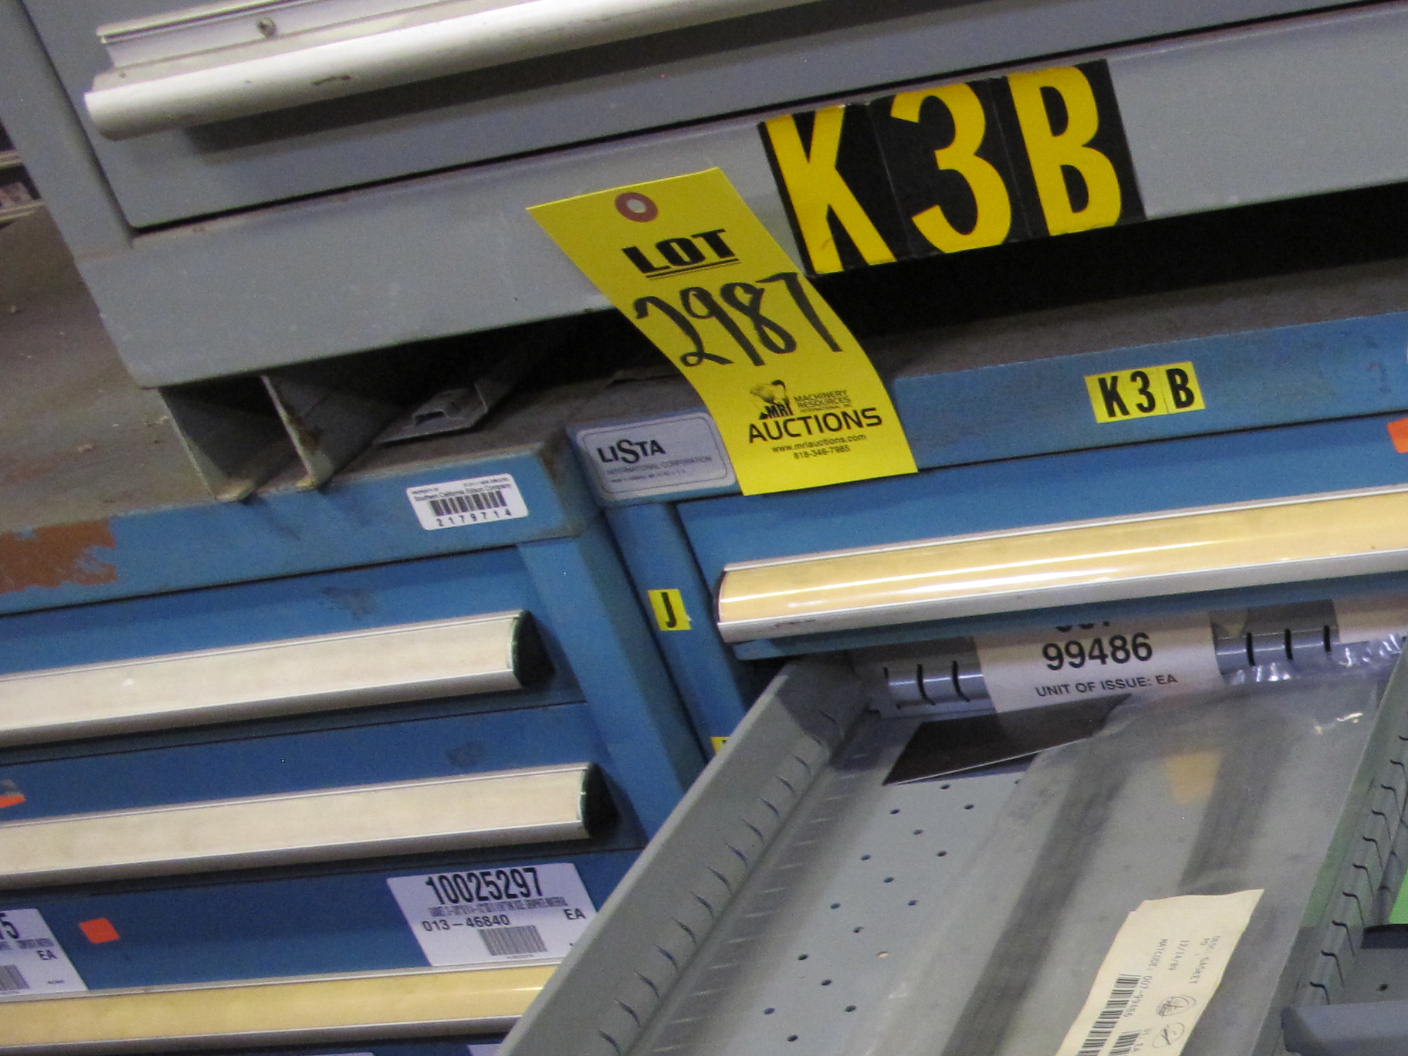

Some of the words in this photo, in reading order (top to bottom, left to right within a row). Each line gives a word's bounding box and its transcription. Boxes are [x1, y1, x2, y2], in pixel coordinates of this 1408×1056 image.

[764, 66, 1122, 274] K3B
[623, 229, 729, 273] LOT
[633, 271, 842, 368] 2987
[1099, 367, 1196, 418] K3B
[749, 407, 882, 443] AUCTIONS
[597, 439, 666, 463] LISTA
[661, 592, 677, 628] J
[1042, 632, 1153, 670] 99486
[1035, 683, 1070, 697] UNIT
[1075, 681, 1096, 693] OF
[1101, 677, 1152, 690] ISSUE:
[1155, 674, 1177, 685] EA
[425, 867, 543, 904] 10025297
[563, 908, 586, 921] EA
[37, 950, 58, 960] EA
